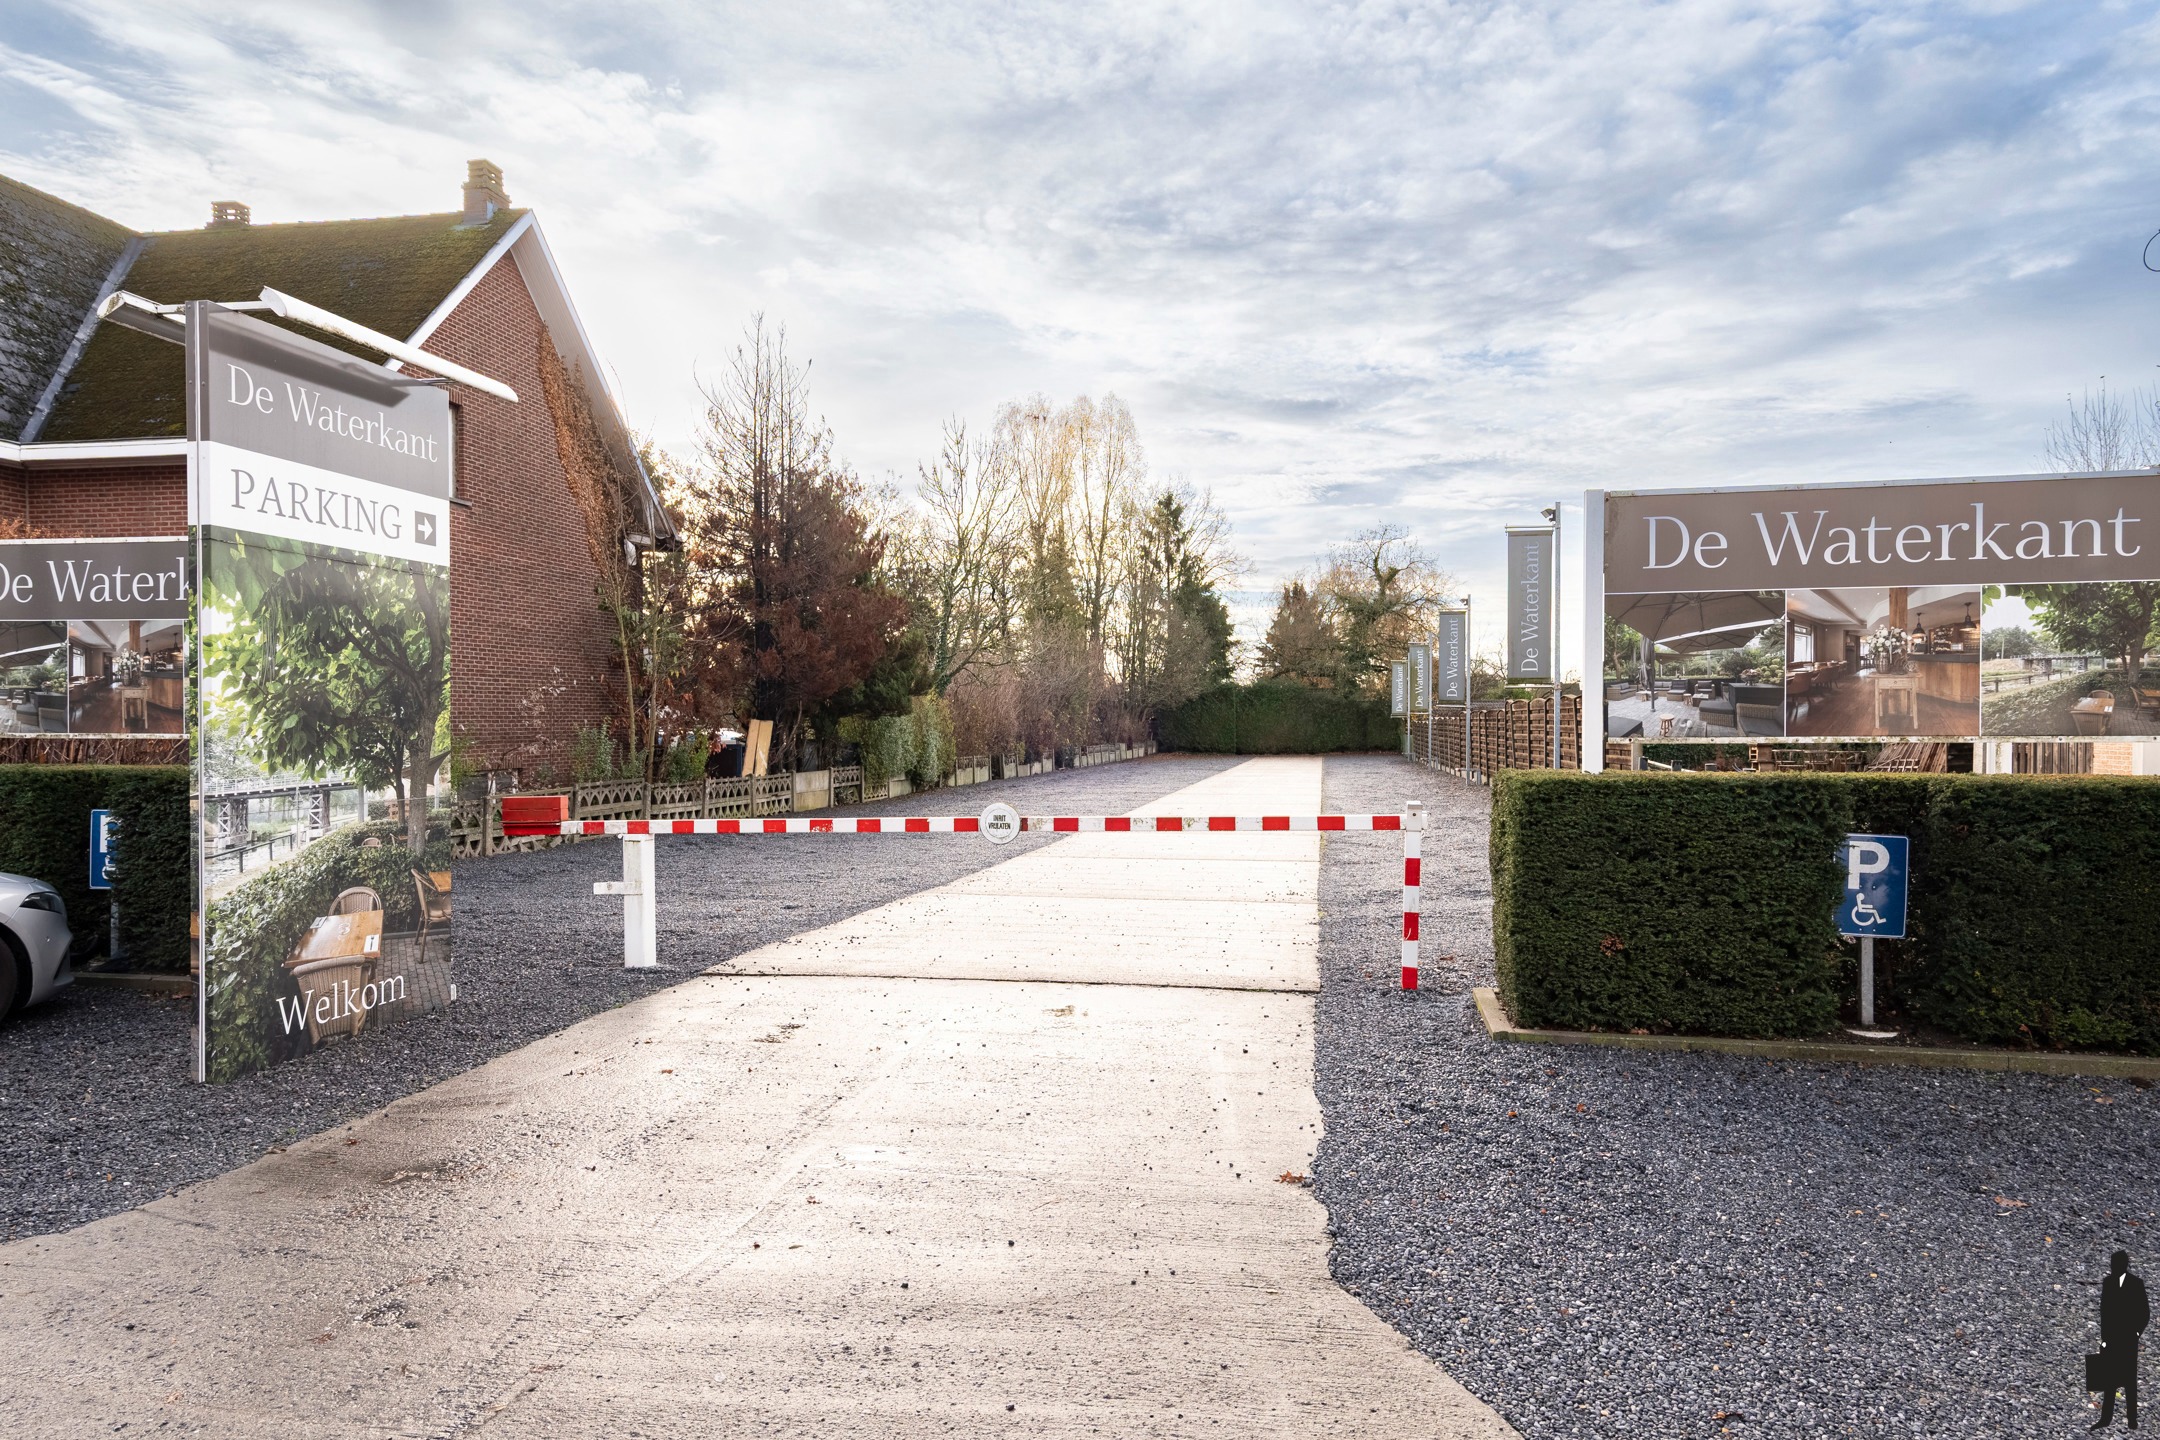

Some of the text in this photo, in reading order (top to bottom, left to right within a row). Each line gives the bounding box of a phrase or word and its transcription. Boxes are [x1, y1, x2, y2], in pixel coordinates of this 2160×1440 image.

[226, 363, 438, 463] De Waterkant
[230, 469, 402, 540] PARKING
[1642, 502, 2142, 570] De Waterkant
[1521, 541, 1540, 673] De Waterkant
[1415, 649, 1424, 707] De Waterkant
[1446, 618, 1459, 697] De Waterkant
[1847, 840, 1890, 889] P
[276, 975, 406, 1035] Welkom
